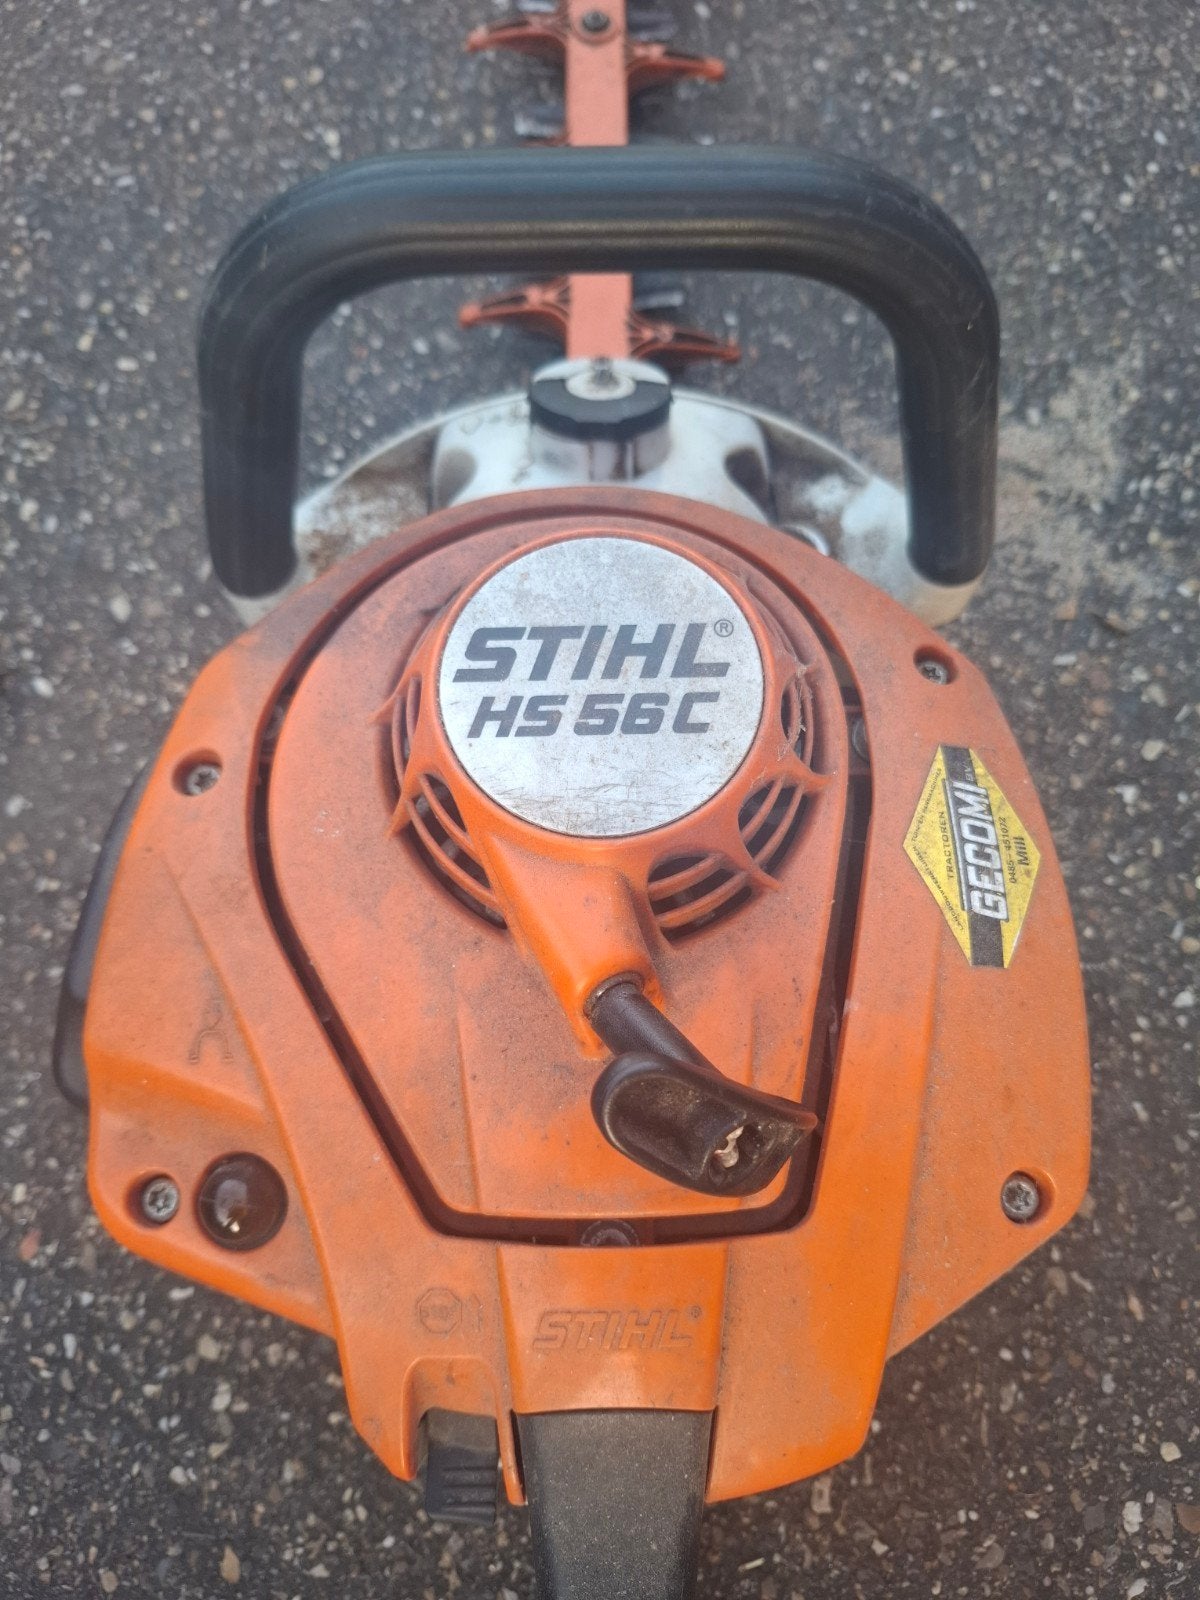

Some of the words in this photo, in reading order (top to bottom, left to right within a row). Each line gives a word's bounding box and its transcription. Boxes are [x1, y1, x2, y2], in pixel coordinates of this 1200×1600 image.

[467, 695, 569, 739] HS
[573, 692, 670, 736] 56
[671, 691, 721, 734] C
[938, 811, 954, 879] TRACTOREN
[951, 780, 1009, 920] GECOMI
[1012, 834, 1032, 867] Mill
